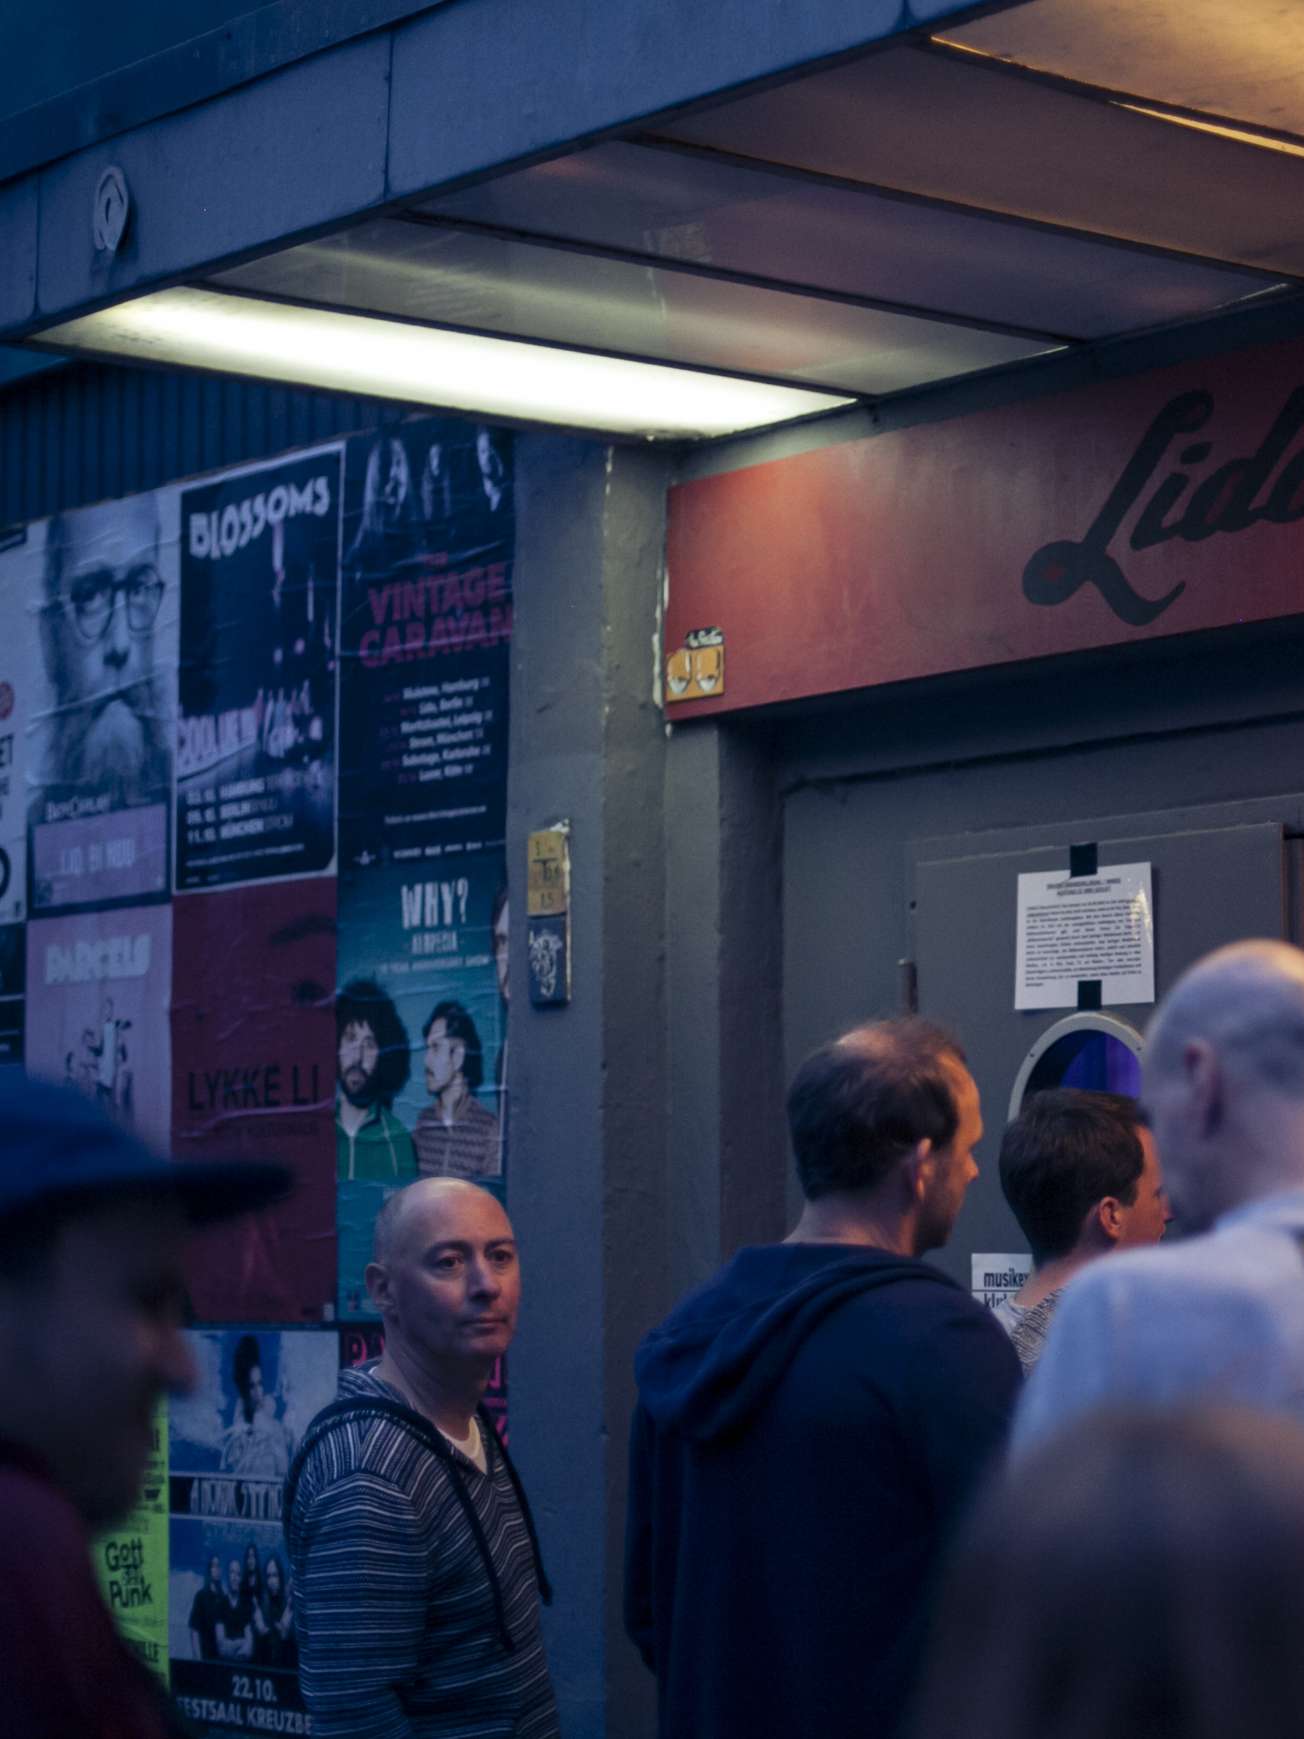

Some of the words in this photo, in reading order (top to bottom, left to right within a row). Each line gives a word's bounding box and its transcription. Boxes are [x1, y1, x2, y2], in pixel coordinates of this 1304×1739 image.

[189, 476, 330, 559] BLOSSOMS
[368, 562, 506, 625] VINTAGE
[401, 877, 469, 930] WHY?
[188, 1064, 281, 1110] LYKKE
[292, 1064, 319, 1106] LI
[105, 1537, 145, 1571] Gott
[110, 1575, 153, 1608] Punk
[232, 1674, 278, 1702] 22.10.
[247, 1704, 313, 1735] KREUZBE
